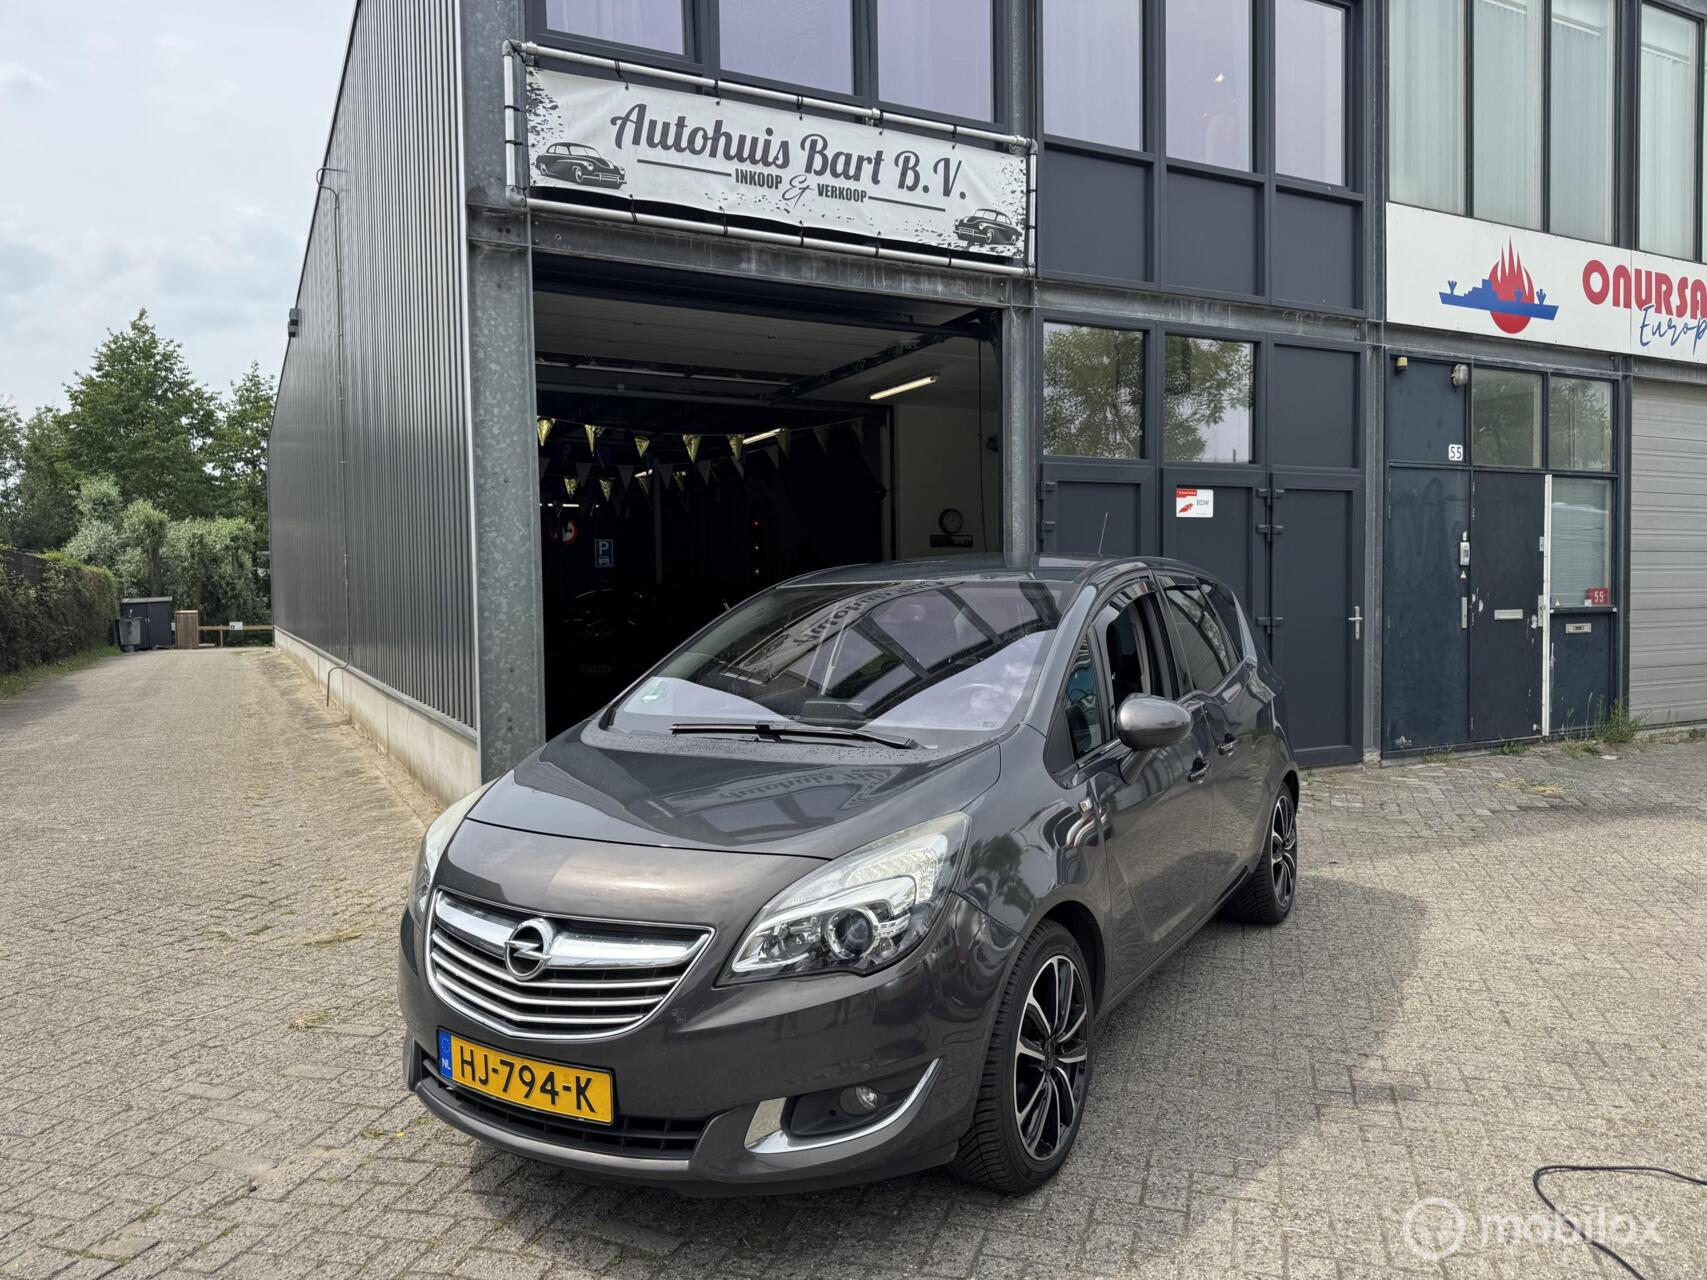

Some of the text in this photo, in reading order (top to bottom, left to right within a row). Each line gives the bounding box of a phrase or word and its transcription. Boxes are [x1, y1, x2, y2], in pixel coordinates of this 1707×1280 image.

[610, 104, 967, 200] Autohuis Bart B.V.
[735, 168, 867, 208] INKOOP & VERKOOP
[1450, 446, 1462, 459] 55
[598, 541, 609, 556] P
[1594, 590, 1605, 603] 55
[441, 1057, 451, 1070] NL
[459, 1045, 596, 1113] HJ-794-K
